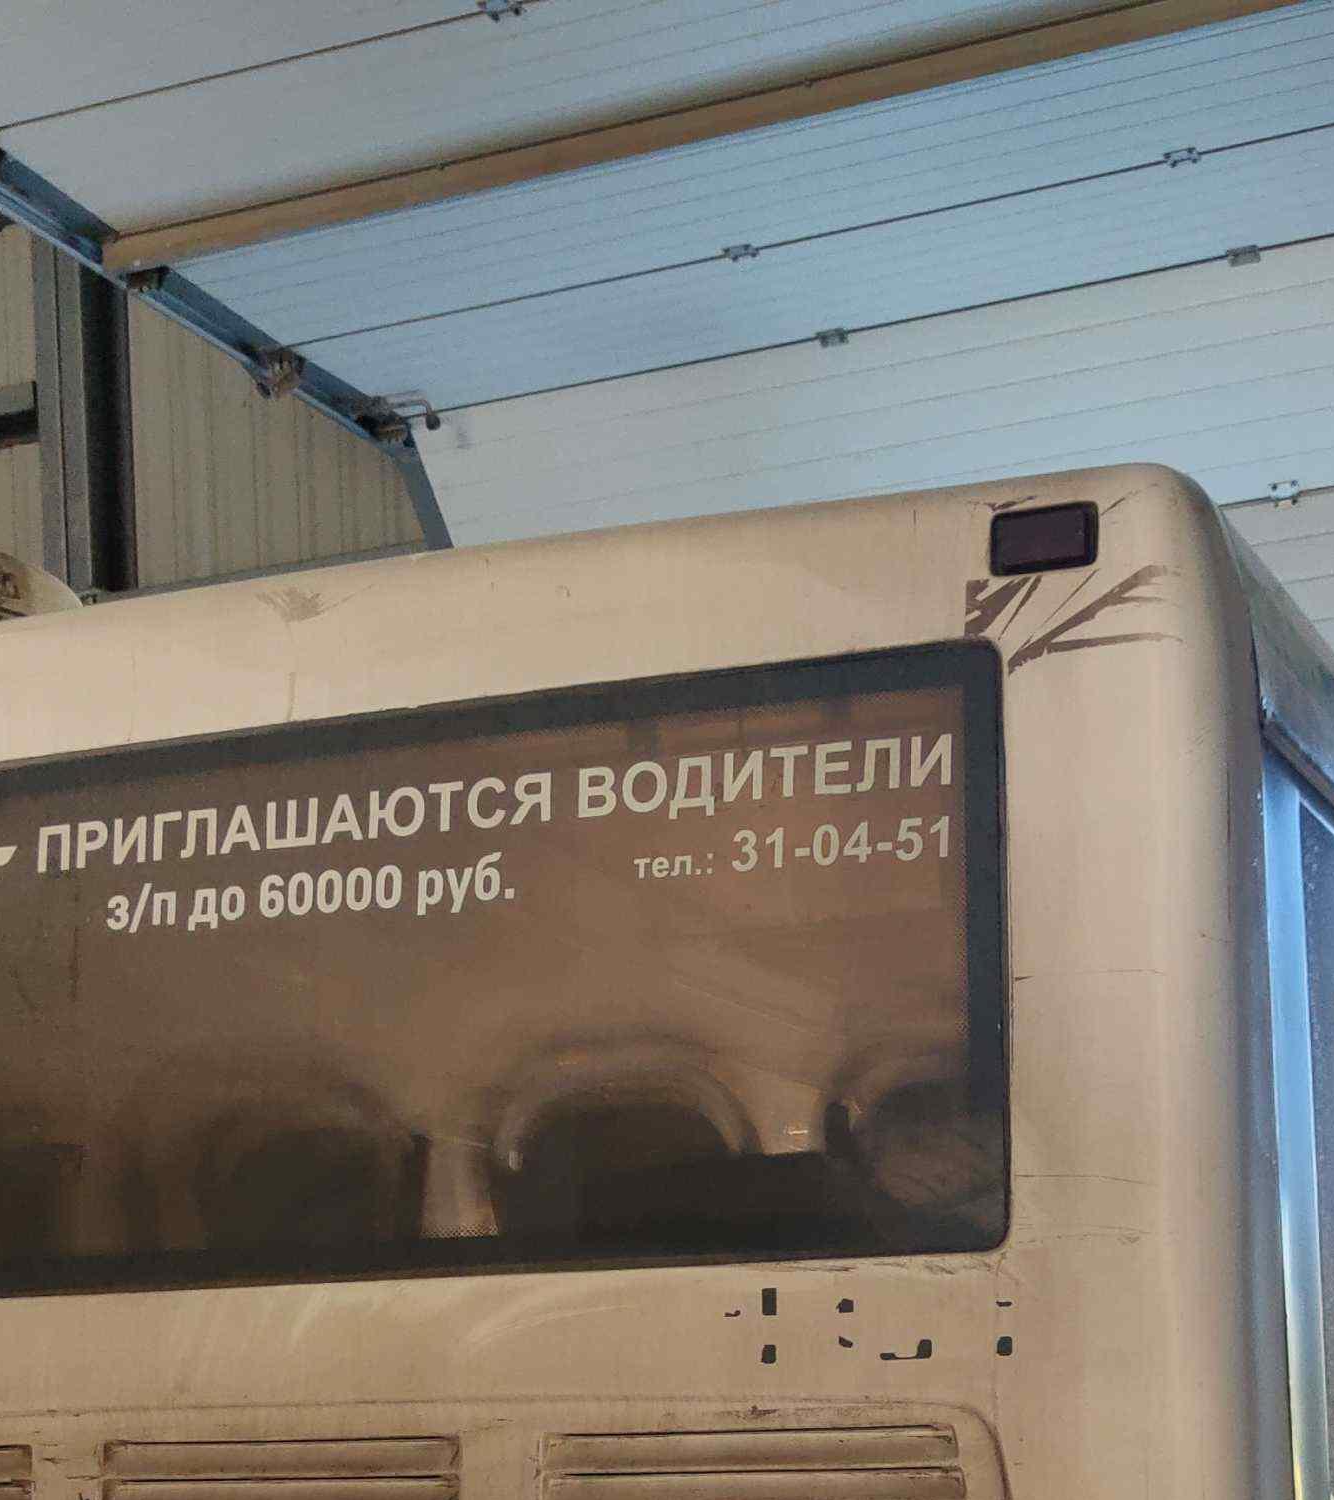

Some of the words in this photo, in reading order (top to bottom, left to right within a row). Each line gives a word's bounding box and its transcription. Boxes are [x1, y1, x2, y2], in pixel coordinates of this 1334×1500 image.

[37, 772, 552, 874] ПРИГЛАШАЮТСЯ
[577, 733, 953, 820] ВОДИТЕЛИ
[633, 850, 714, 880] тел.:
[731, 815, 949, 873] 31-04-51
[187, 886, 246, 932] до
[258, 864, 403, 919] 60000
[416, 851, 516, 916] руб.
